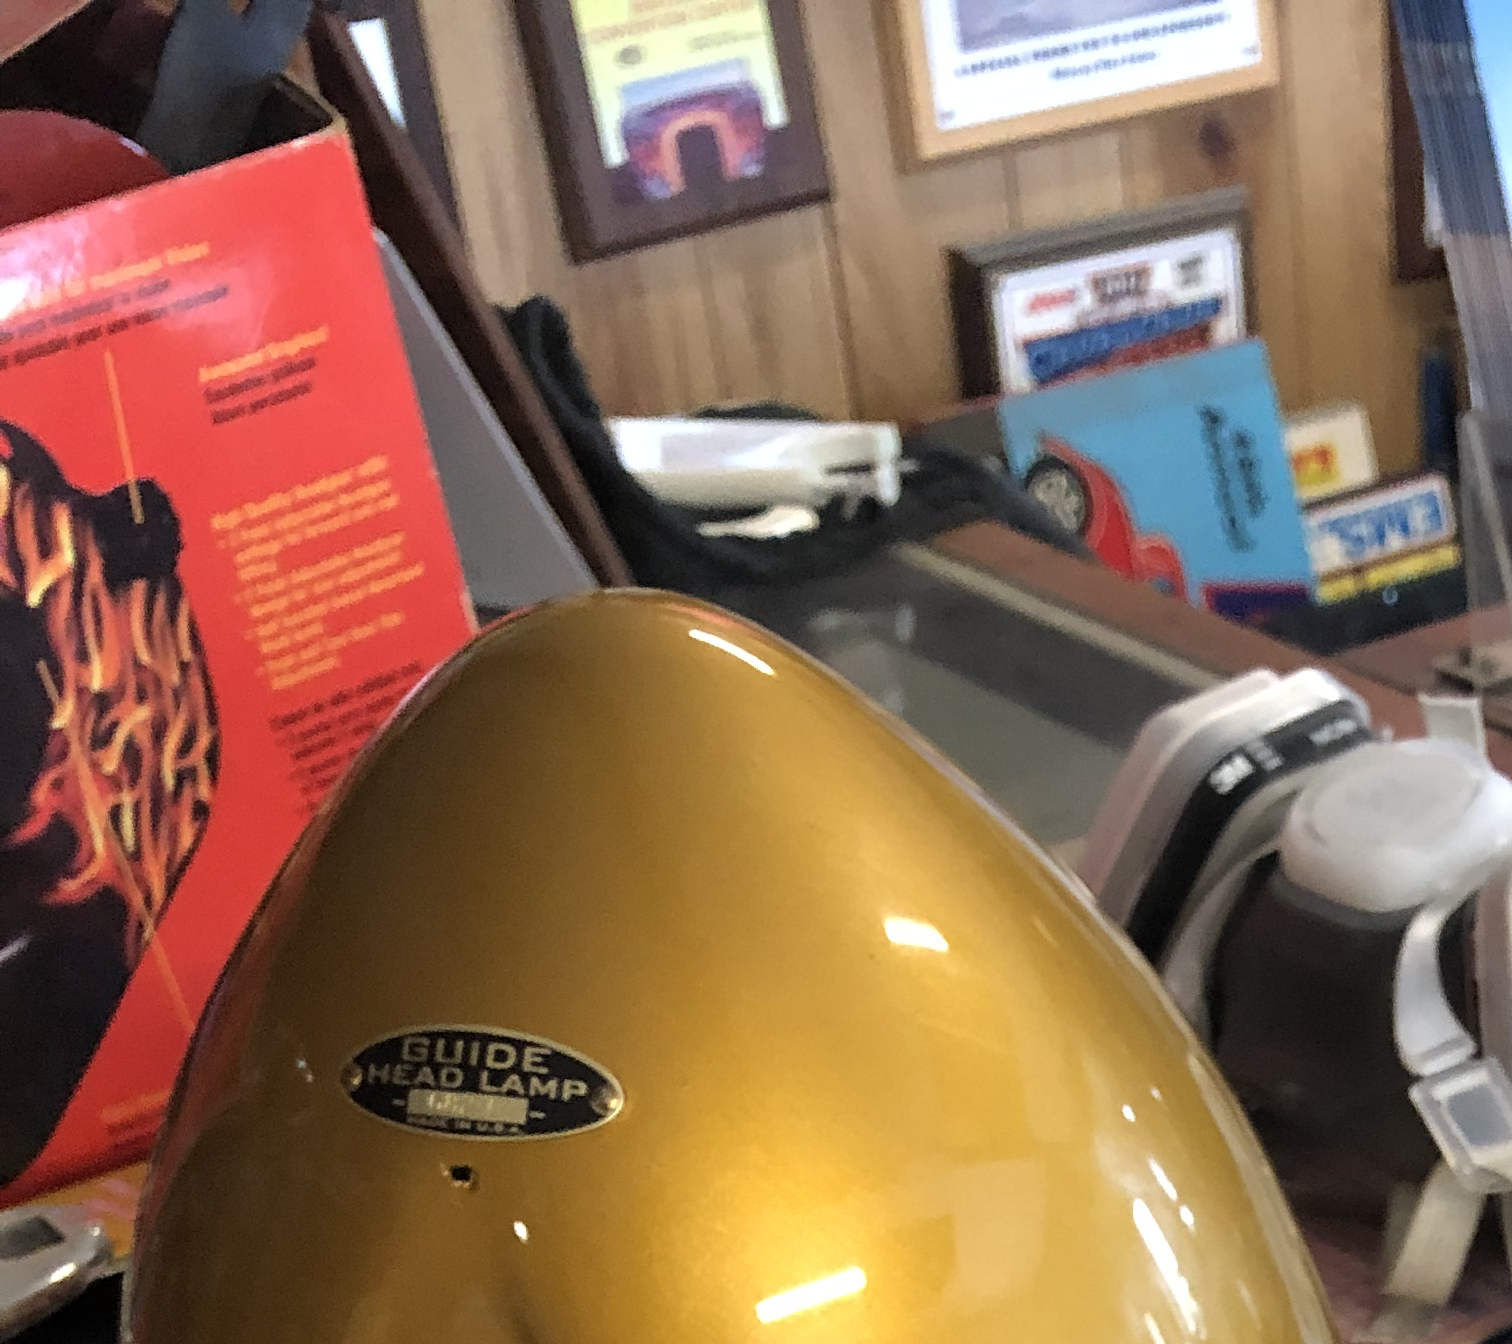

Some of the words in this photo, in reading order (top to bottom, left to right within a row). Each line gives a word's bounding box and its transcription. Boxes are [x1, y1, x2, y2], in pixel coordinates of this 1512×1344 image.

[401, 1035, 550, 1075] GUIDE
[367, 1062, 465, 1090] HEAD
[478, 1069, 589, 1103] LAMP
